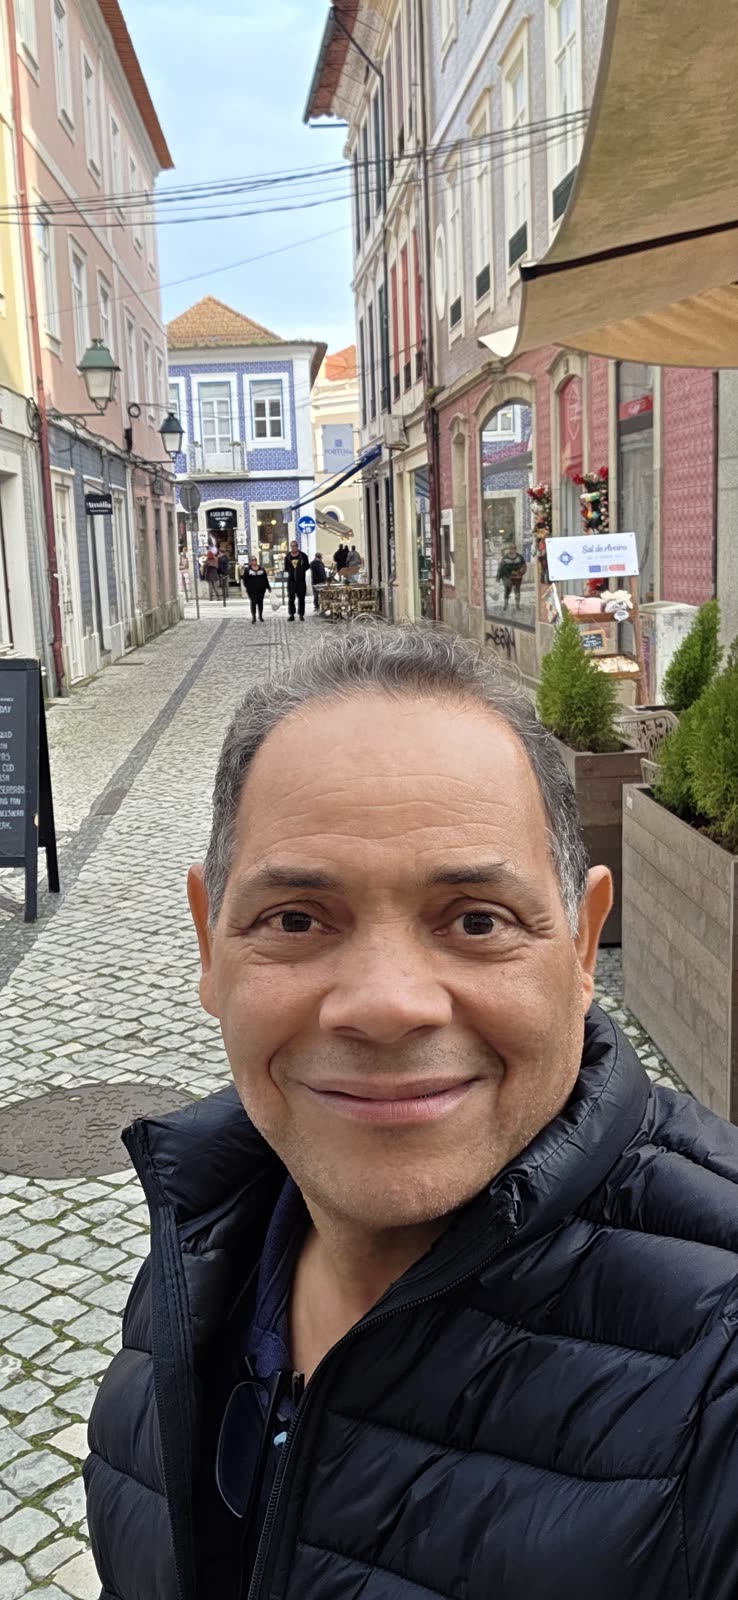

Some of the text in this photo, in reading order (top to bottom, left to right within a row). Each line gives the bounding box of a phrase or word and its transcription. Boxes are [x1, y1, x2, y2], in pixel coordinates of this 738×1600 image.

[582, 543, 628, 554] Sal de Aveiro
